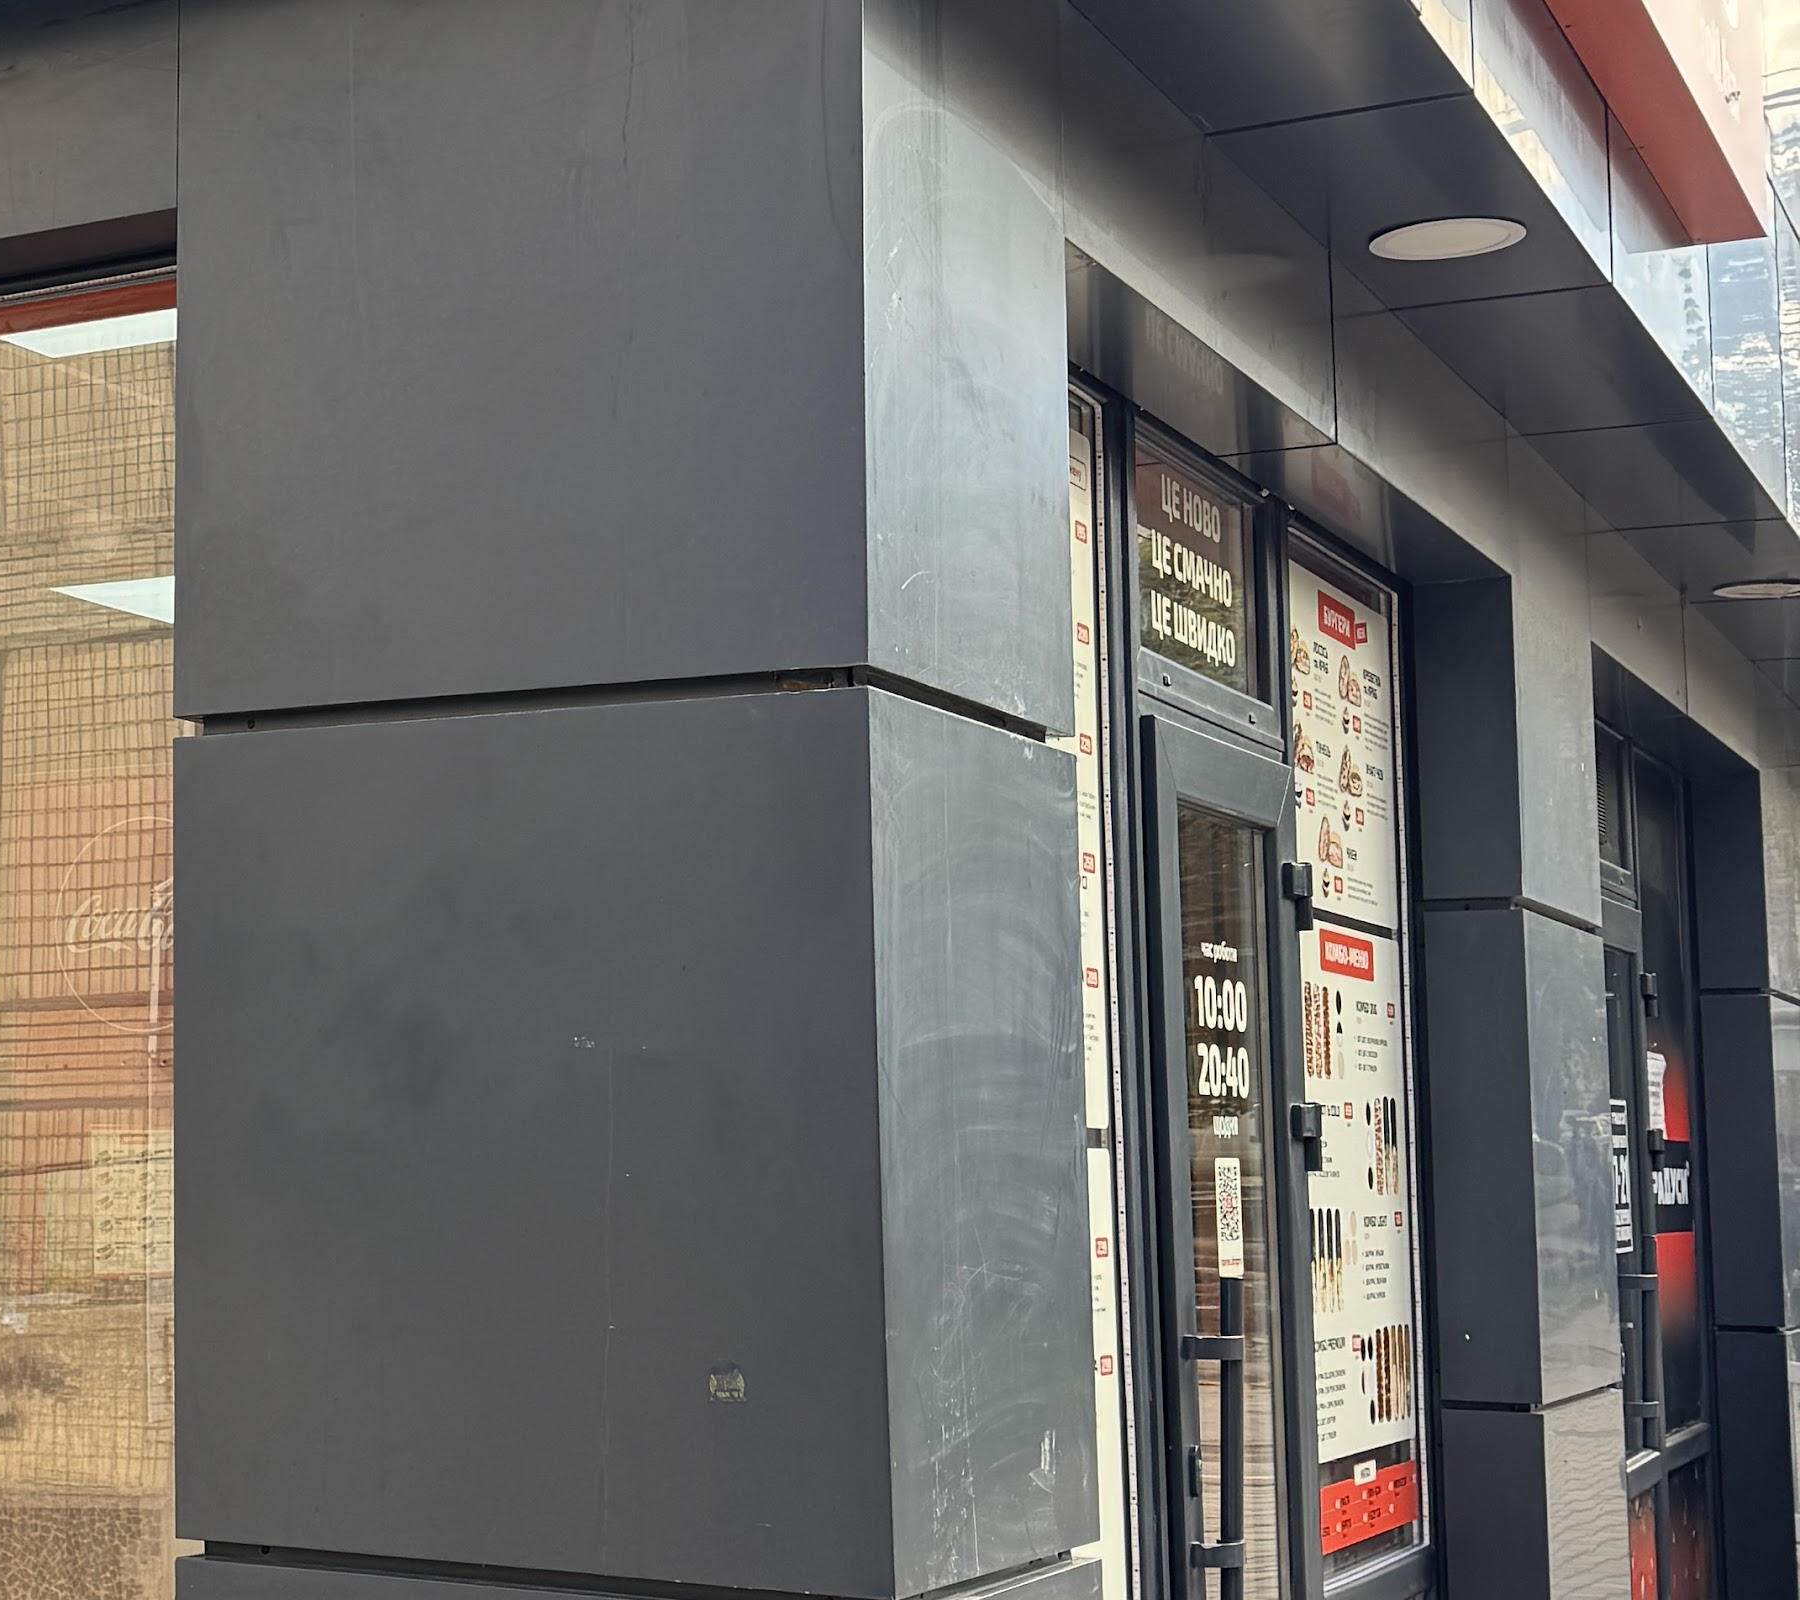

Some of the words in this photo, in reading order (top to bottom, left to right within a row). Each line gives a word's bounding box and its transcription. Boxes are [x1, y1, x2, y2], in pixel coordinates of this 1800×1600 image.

[1161, 473, 1181, 523] ЦЕ
[1183, 487, 1221, 543] НОВО
[1151, 528, 1171, 579] ЦЕ
[1173, 542, 1233, 608] СМАЧНО
[1151, 589, 1172, 641] ЦЕ
[1173, 601, 1236, 668] ШВИДКО
[1194, 974, 1247, 1033] 10:00
[1198, 1042, 1250, 1099] 20:40
